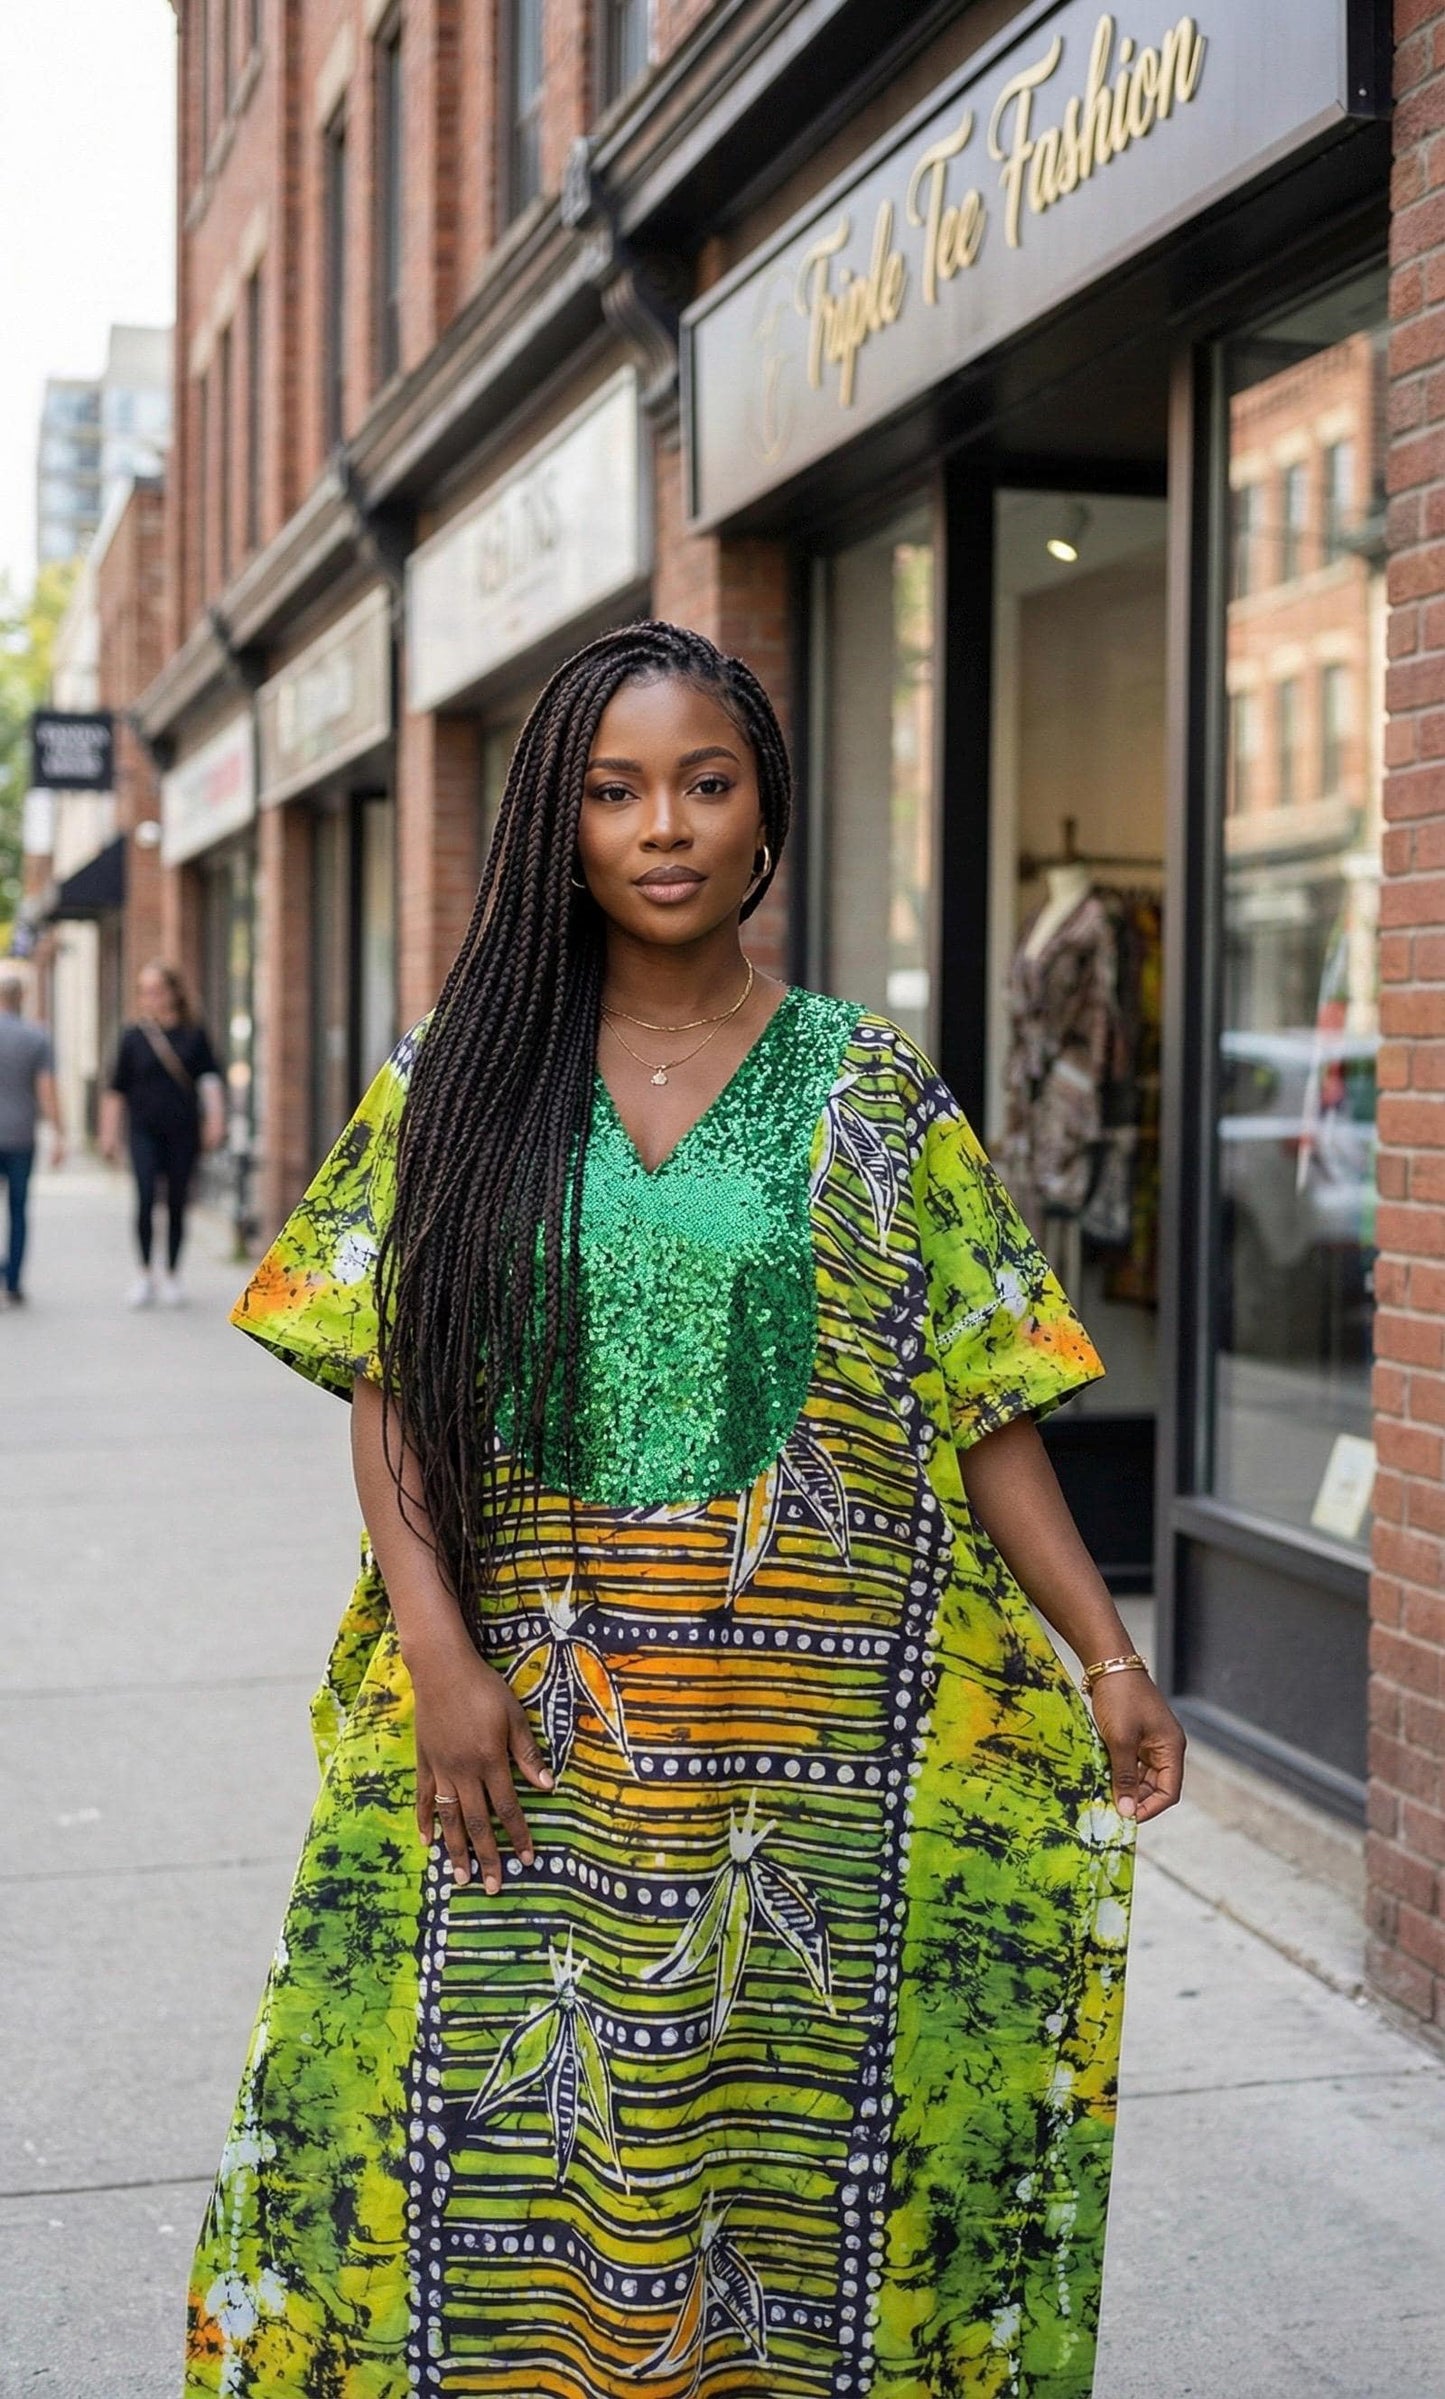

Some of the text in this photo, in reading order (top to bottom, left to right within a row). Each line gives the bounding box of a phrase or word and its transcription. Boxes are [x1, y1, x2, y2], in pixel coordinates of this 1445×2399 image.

[797, 13, 1205, 406] Triple Tee Fashion
